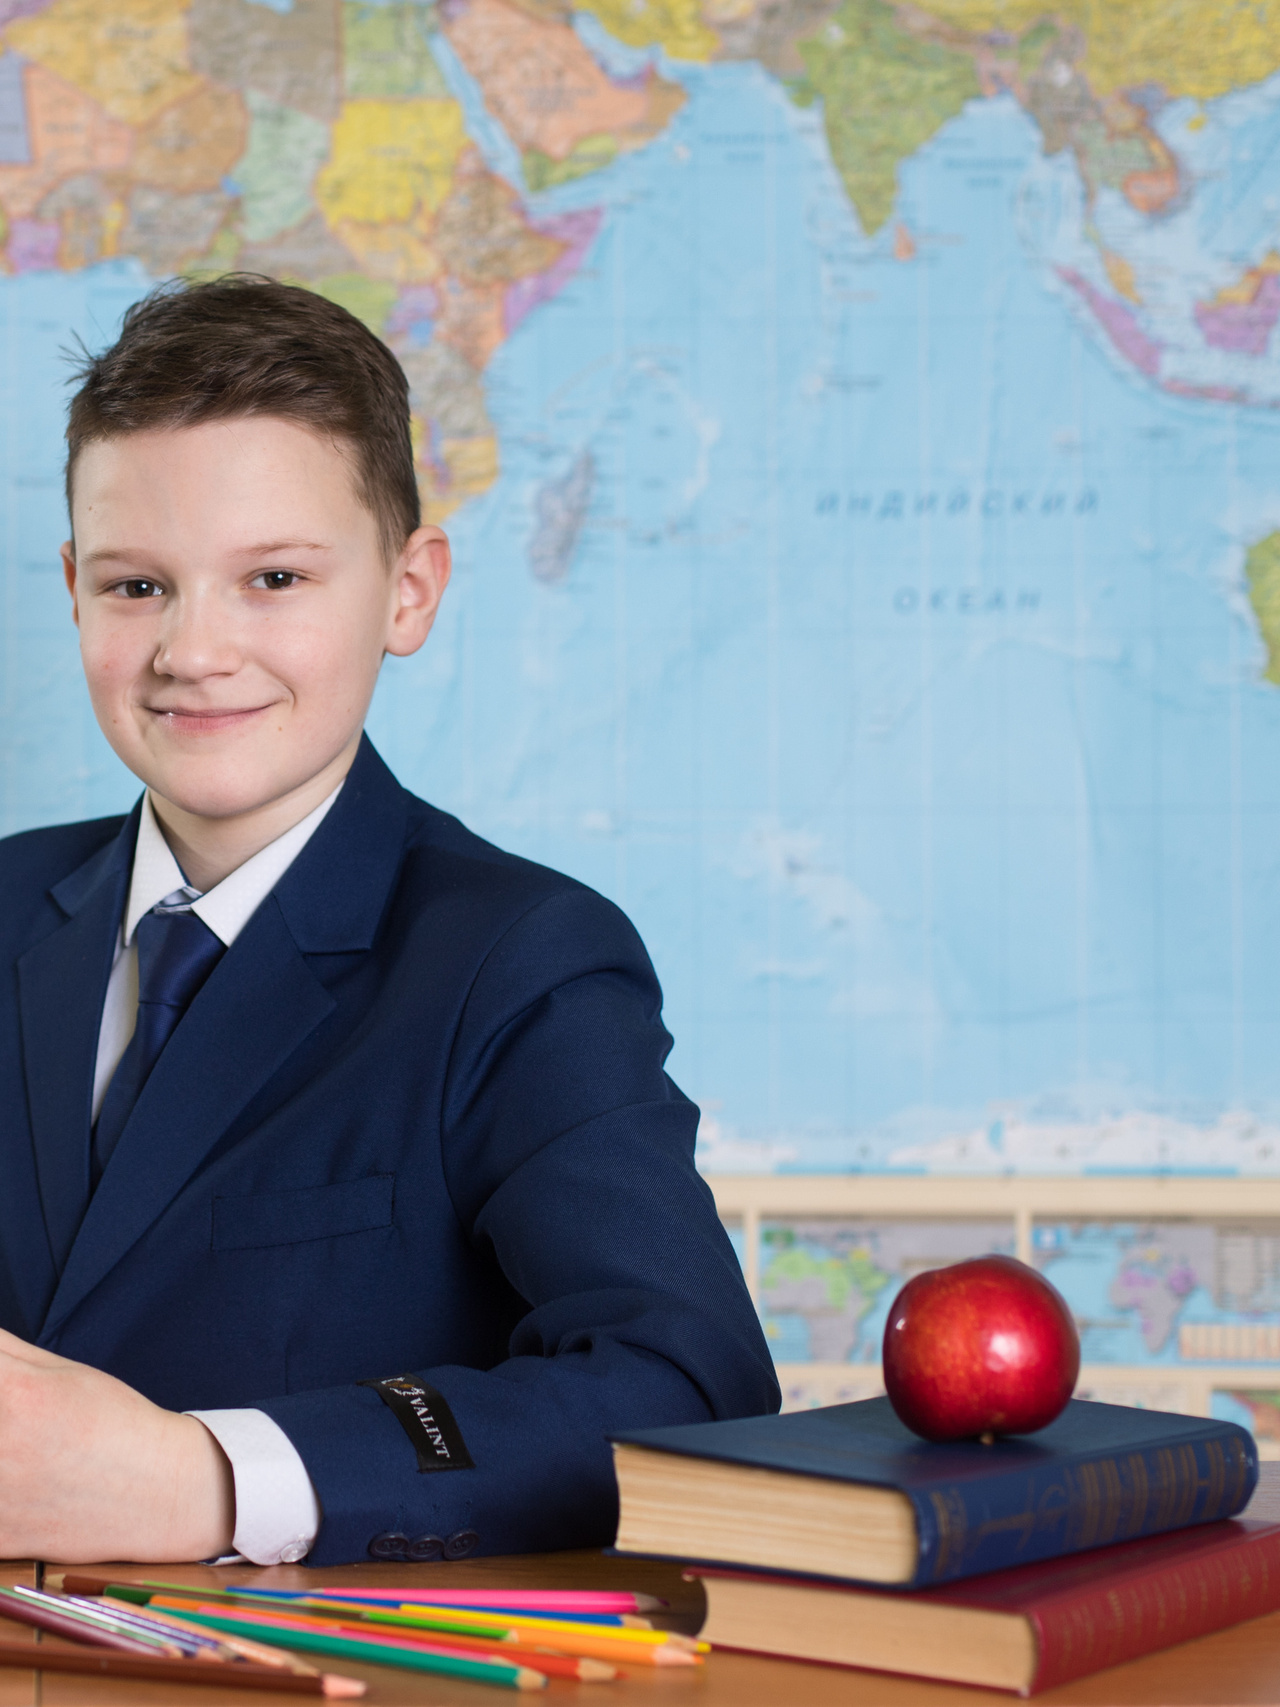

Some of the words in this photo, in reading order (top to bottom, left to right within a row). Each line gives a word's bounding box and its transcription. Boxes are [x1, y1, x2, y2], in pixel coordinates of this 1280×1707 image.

[815, 486, 1100, 520] ИНДИЙСКИЙ
[892, 586, 1041, 616] ОКЕАН
[410, 1397, 451, 1459] VALINT
